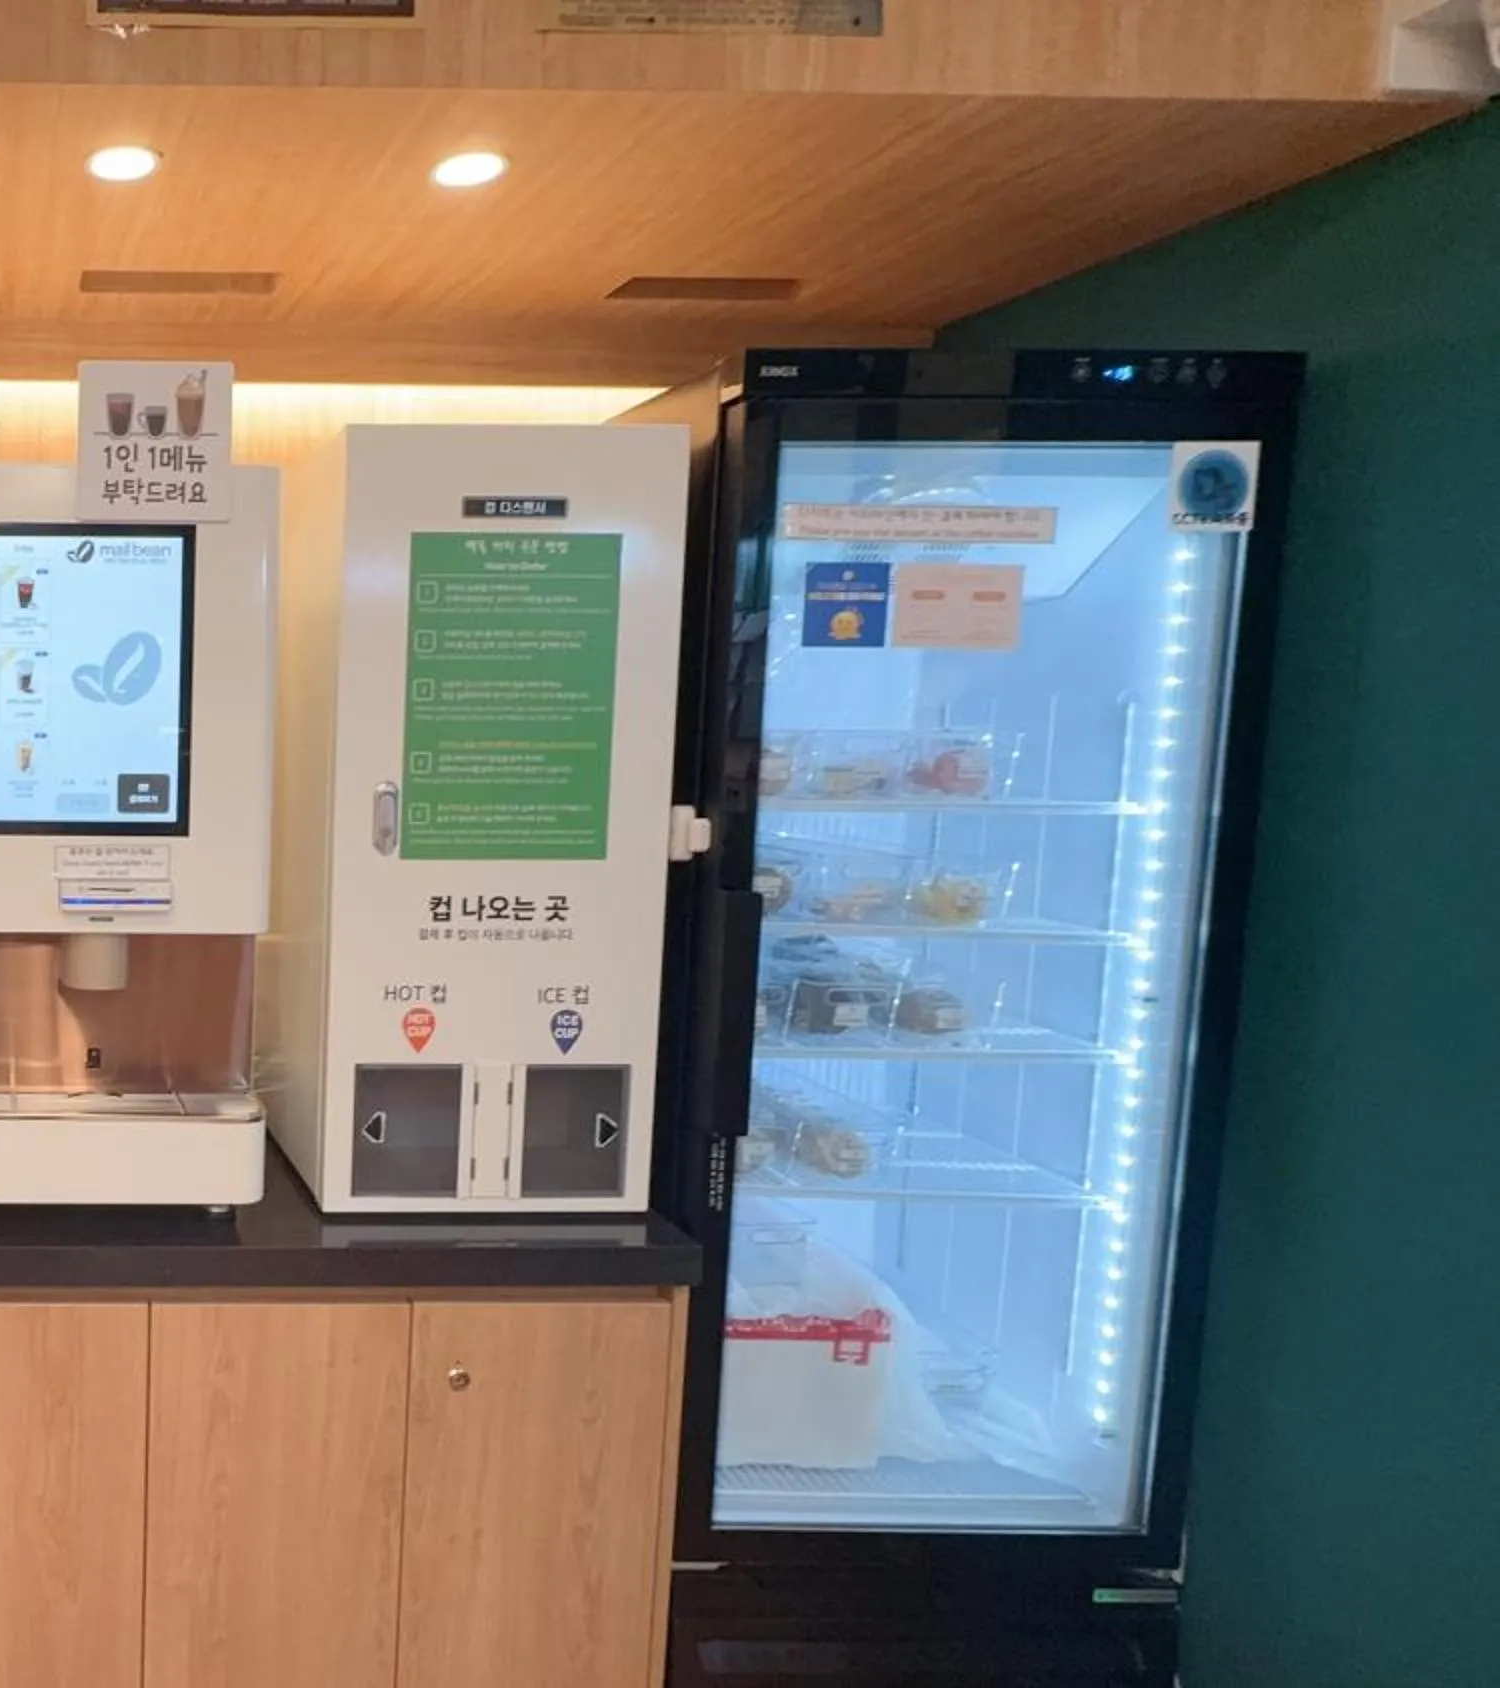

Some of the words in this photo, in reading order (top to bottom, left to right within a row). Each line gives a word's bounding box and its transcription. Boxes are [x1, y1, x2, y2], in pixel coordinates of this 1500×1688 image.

[103, 442, 139, 473] 1인
[147, 444, 208, 473] 1메뉴
[101, 477, 208, 506] 부탁드려요
[499, 500, 547, 516] 디스펜서
[429, 895, 452, 922] 컵
[461, 895, 536, 922] 나오는
[544, 895, 570, 921] 곳
[383, 985, 424, 1001] HOT
[431, 984, 447, 1004] 컵
[537, 987, 566, 1004] ICE
[572, 985, 590, 1005] 컵
[407, 1013, 431, 1025] HOT
[556, 1015, 578, 1026] ICE
[407, 1025, 432, 1037] CUP
[554, 1026, 578, 1039] CUP
